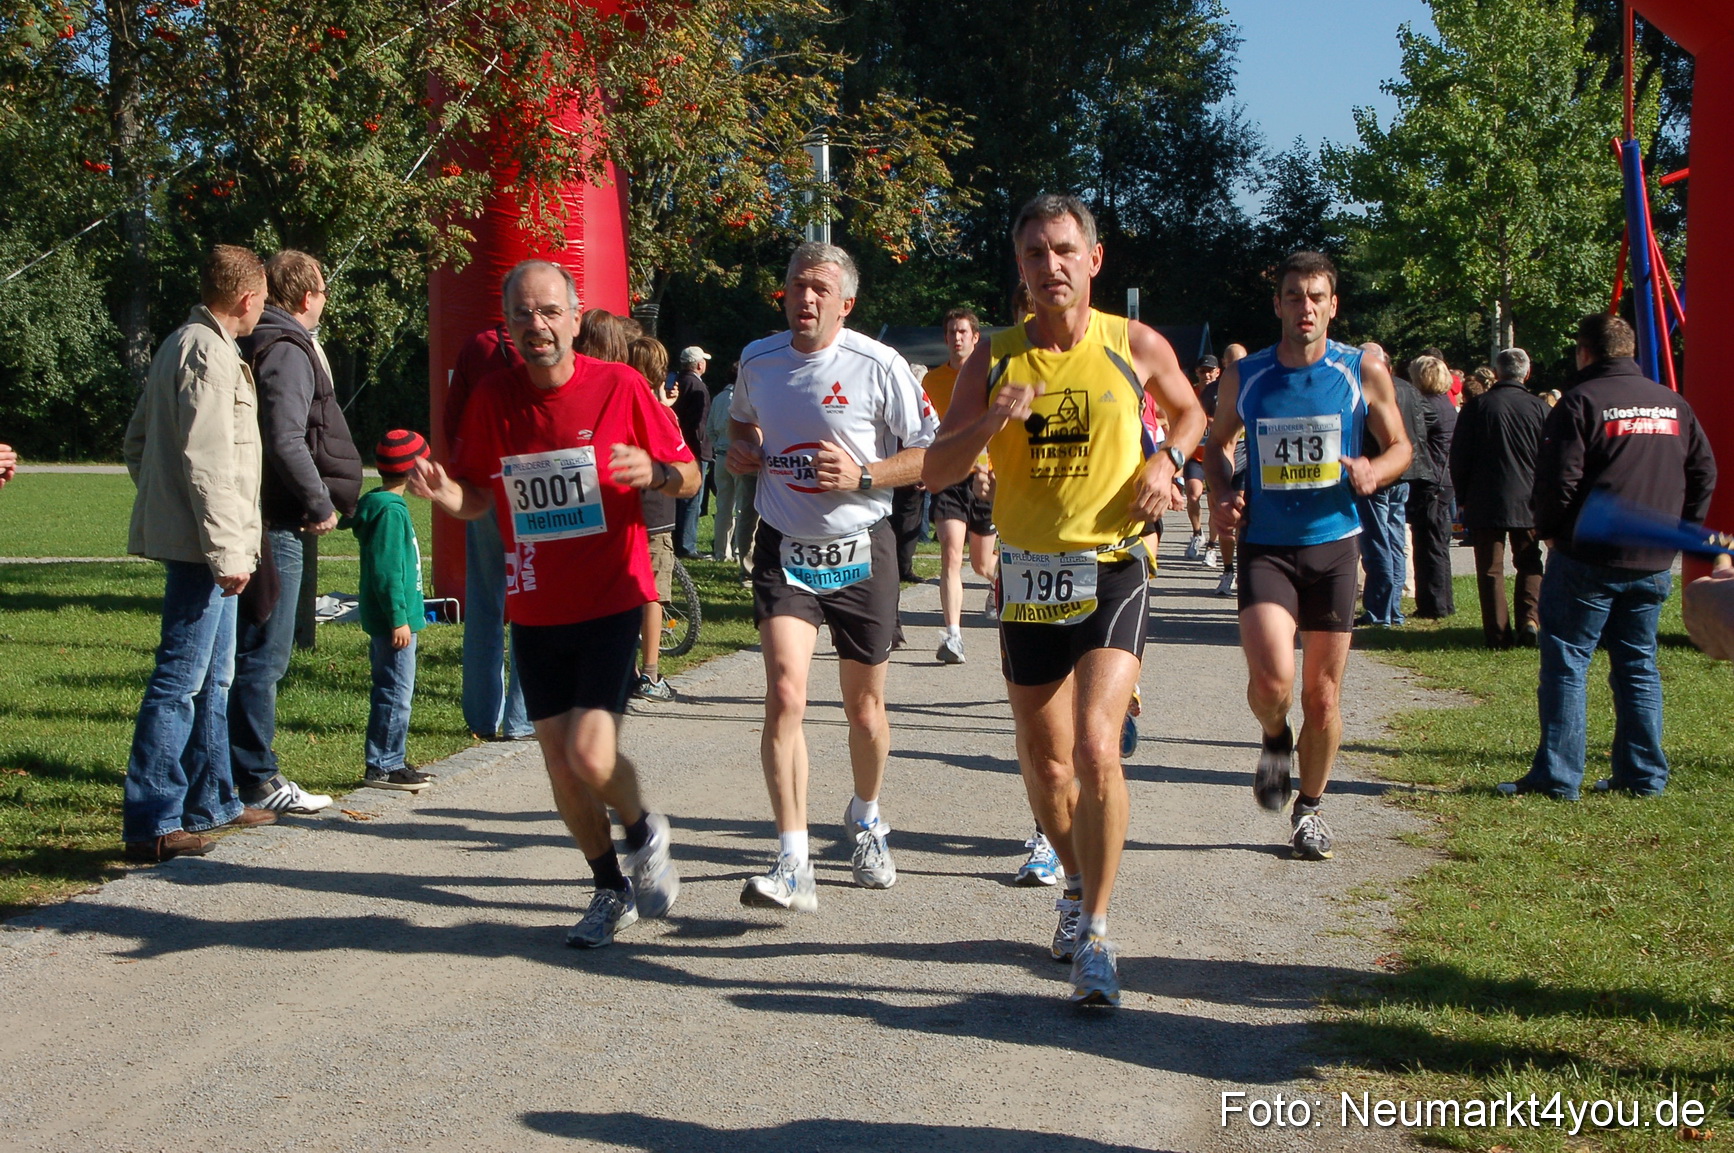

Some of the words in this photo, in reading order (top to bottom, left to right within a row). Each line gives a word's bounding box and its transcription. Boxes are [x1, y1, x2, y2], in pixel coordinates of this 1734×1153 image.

[1603, 406, 1677, 421] Klostergold
[1030, 446, 1088, 459] HIRSCH
[1275, 436, 1324, 463] 413
[1280, 464, 1321, 480] André
[514, 471, 586, 511] 3001
[526, 508, 585, 530] Helmut
[790, 540, 859, 568] 3387
[793, 567, 860, 585] Hermann
[1021, 569, 1074, 601] 196
